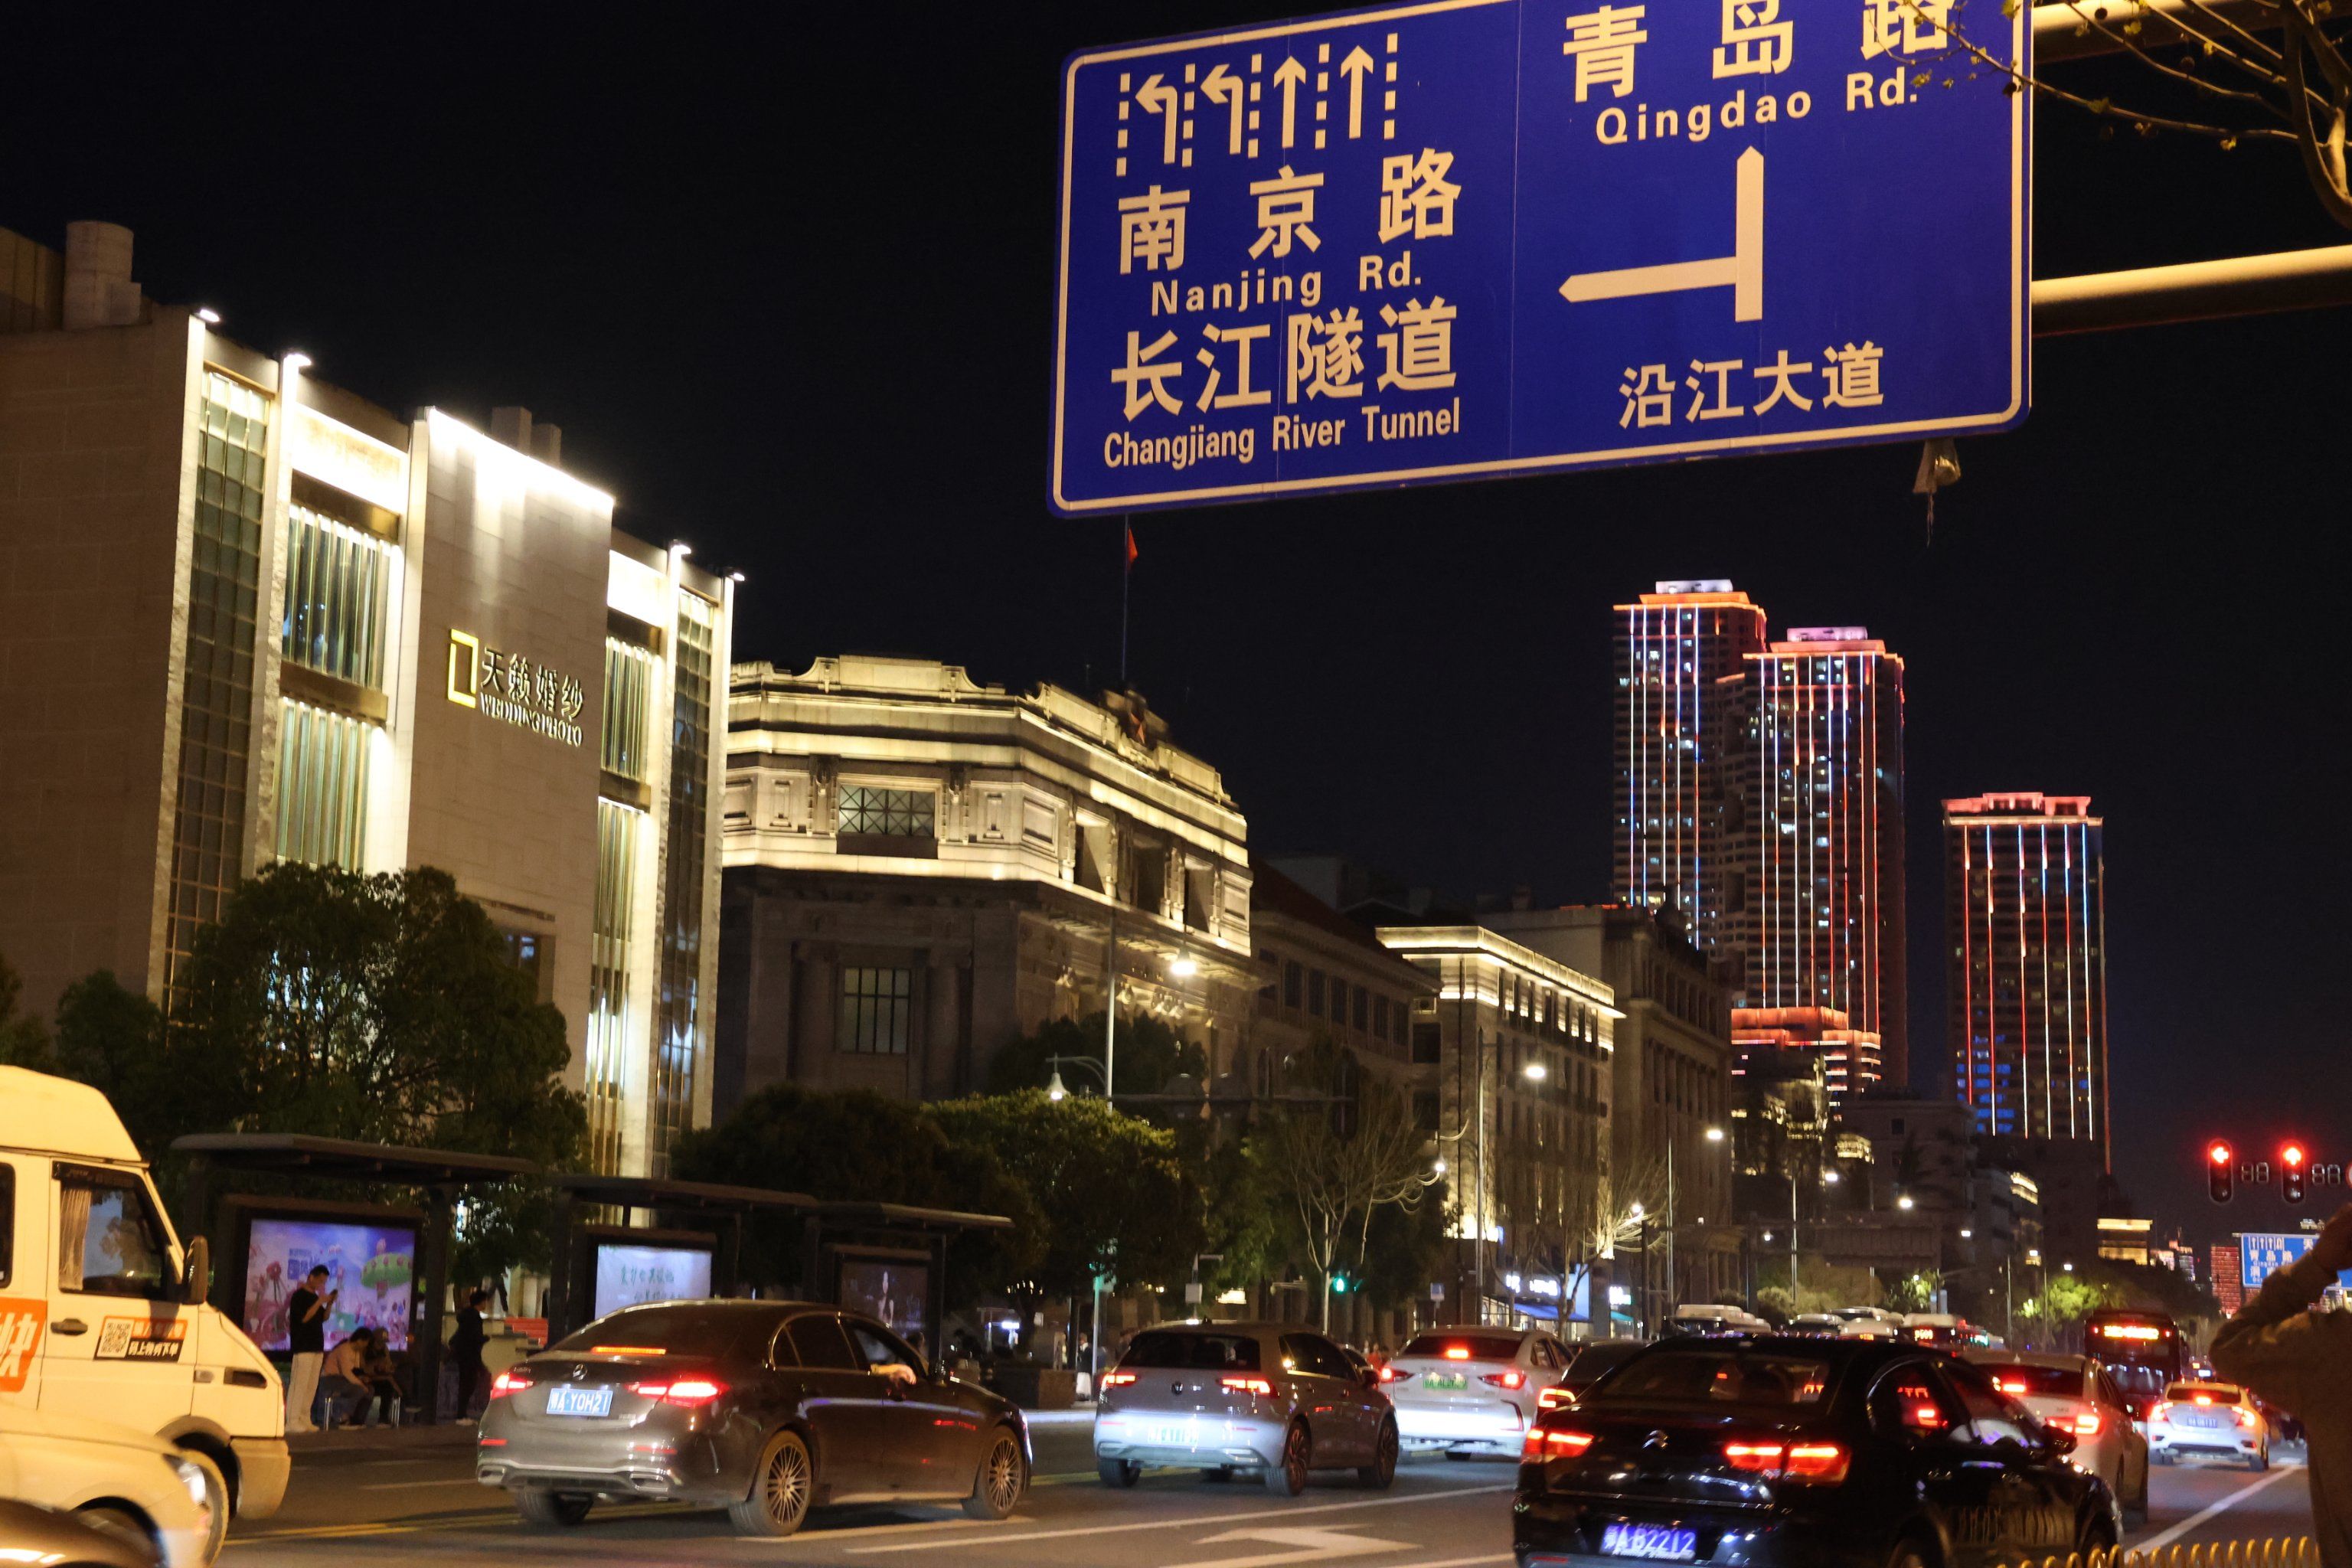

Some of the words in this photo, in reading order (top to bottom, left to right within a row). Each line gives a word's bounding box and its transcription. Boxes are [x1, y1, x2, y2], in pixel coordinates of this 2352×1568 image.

[1563, 0, 1955, 103] 青岛路
[1596, 90, 1811, 145] Qingdao
[1847, 67, 1918, 111] Rd.
[1119, 148, 1462, 274] 南京路
[1152, 269, 1321, 316] Nanjing
[1359, 251, 1422, 291] Rd.
[1111, 296, 1457, 422] 长江隧道
[1619, 341, 1884, 429] 沿江大道
[1104, 425, 1255, 469] Changjiang
[1272, 414, 1346, 451] River
[1361, 397, 1460, 442] Tunnel
